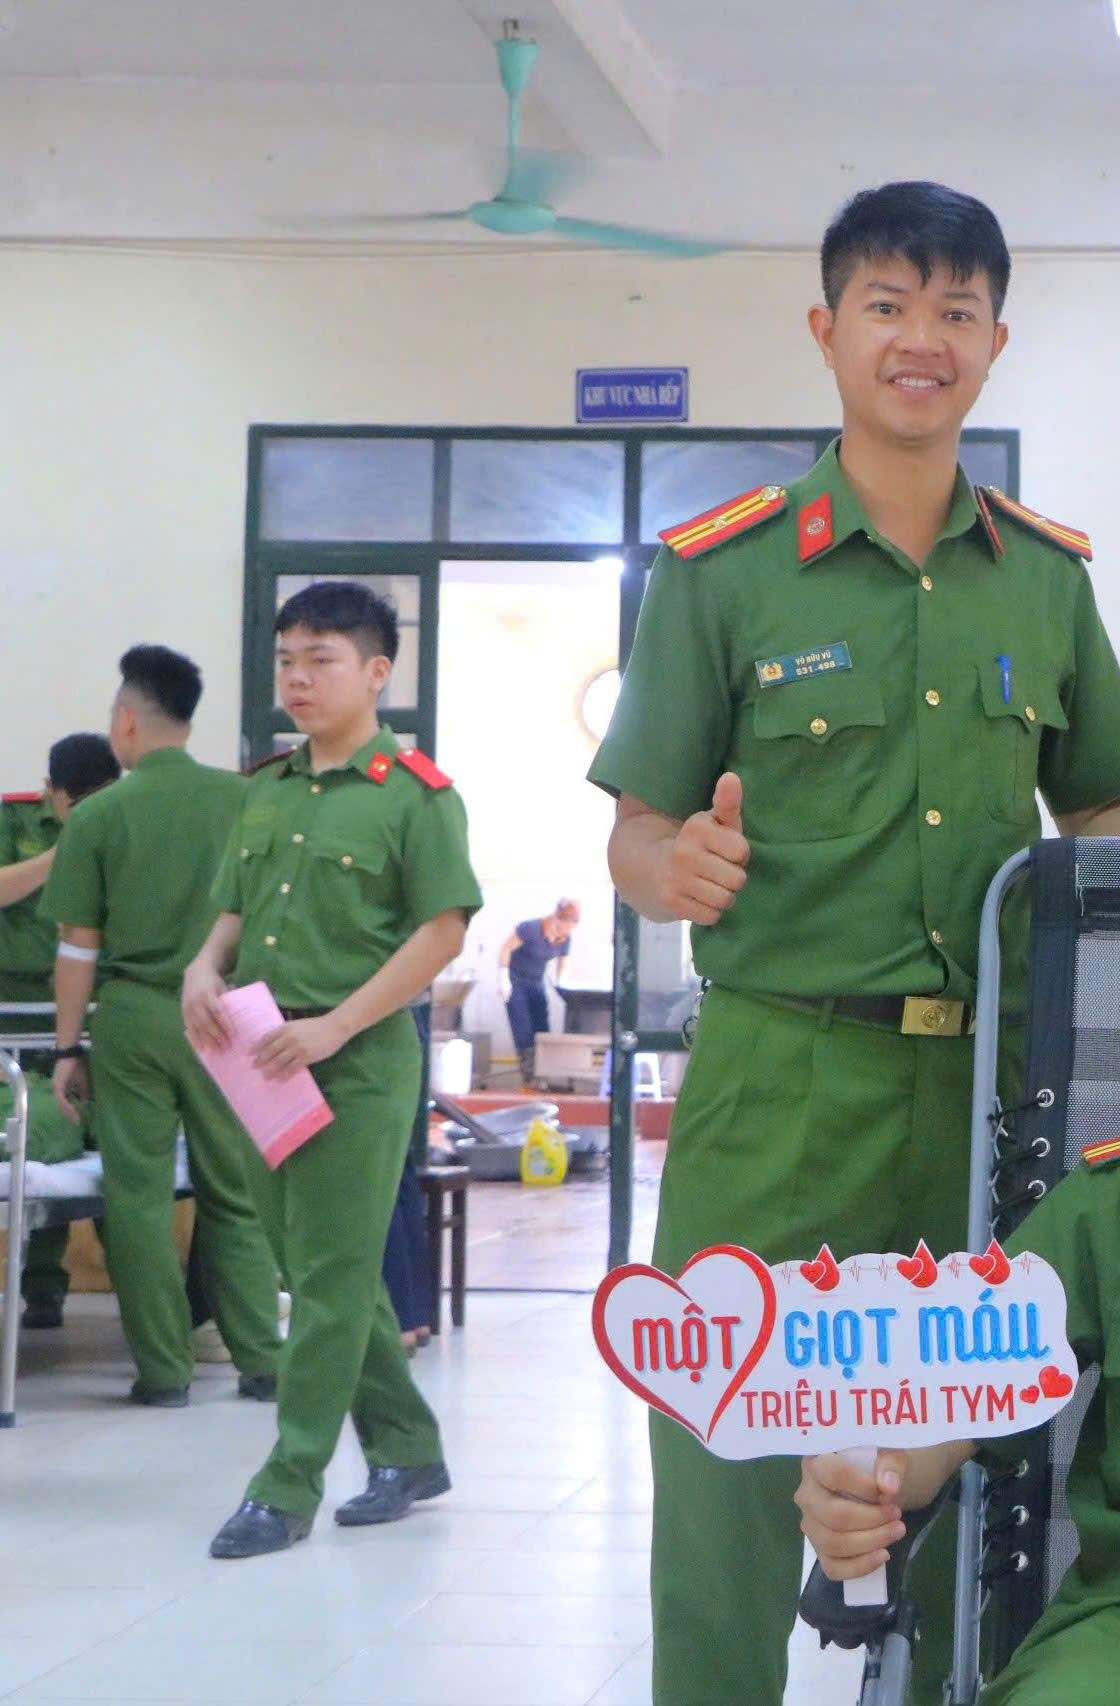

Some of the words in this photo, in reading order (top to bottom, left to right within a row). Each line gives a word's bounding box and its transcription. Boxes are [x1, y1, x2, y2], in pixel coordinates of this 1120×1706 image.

[632, 1302, 742, 1383] MỘT
[784, 1307, 898, 1380] GIỌT
[918, 1287, 1051, 1366] MÁU
[741, 1379, 838, 1436] TRIỆU
[850, 1378, 929, 1426] TRÁI
[940, 1383, 1016, 1424] TYM
